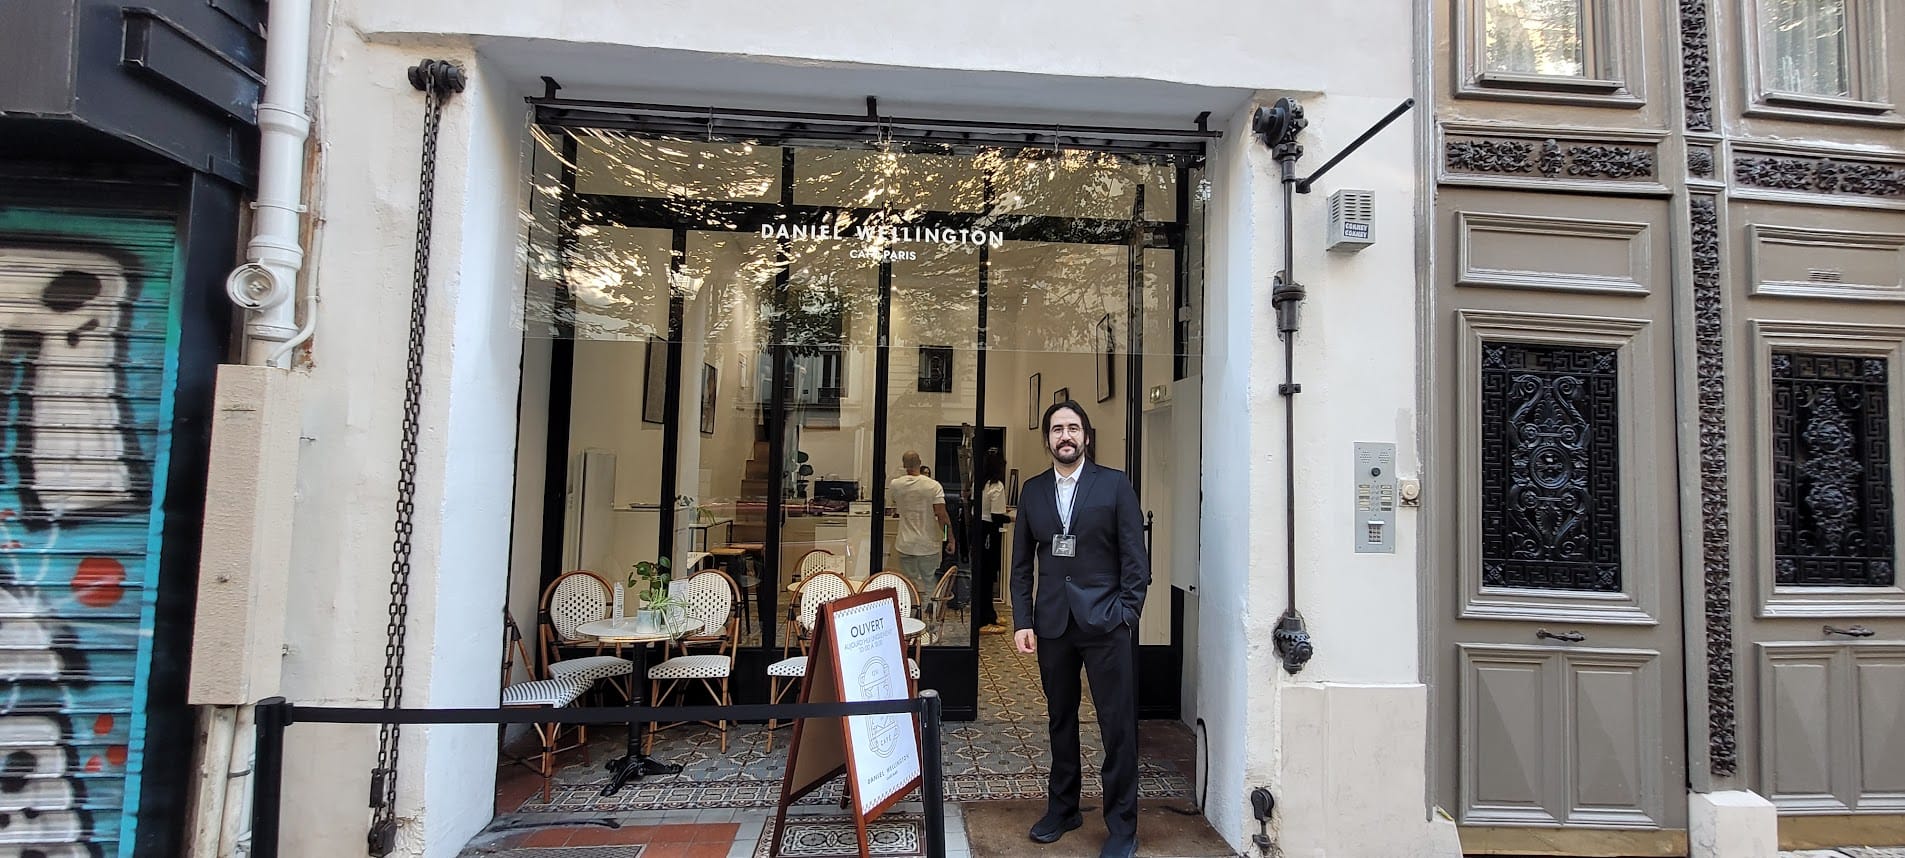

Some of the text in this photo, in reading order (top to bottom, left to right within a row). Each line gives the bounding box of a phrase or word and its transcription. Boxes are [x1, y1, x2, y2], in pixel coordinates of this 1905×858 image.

[761, 223, 1004, 246] DANIEL WELLINGTON
[849, 248, 917, 260] CAF PARIS
[850, 618, 884, 637] OUVERT
